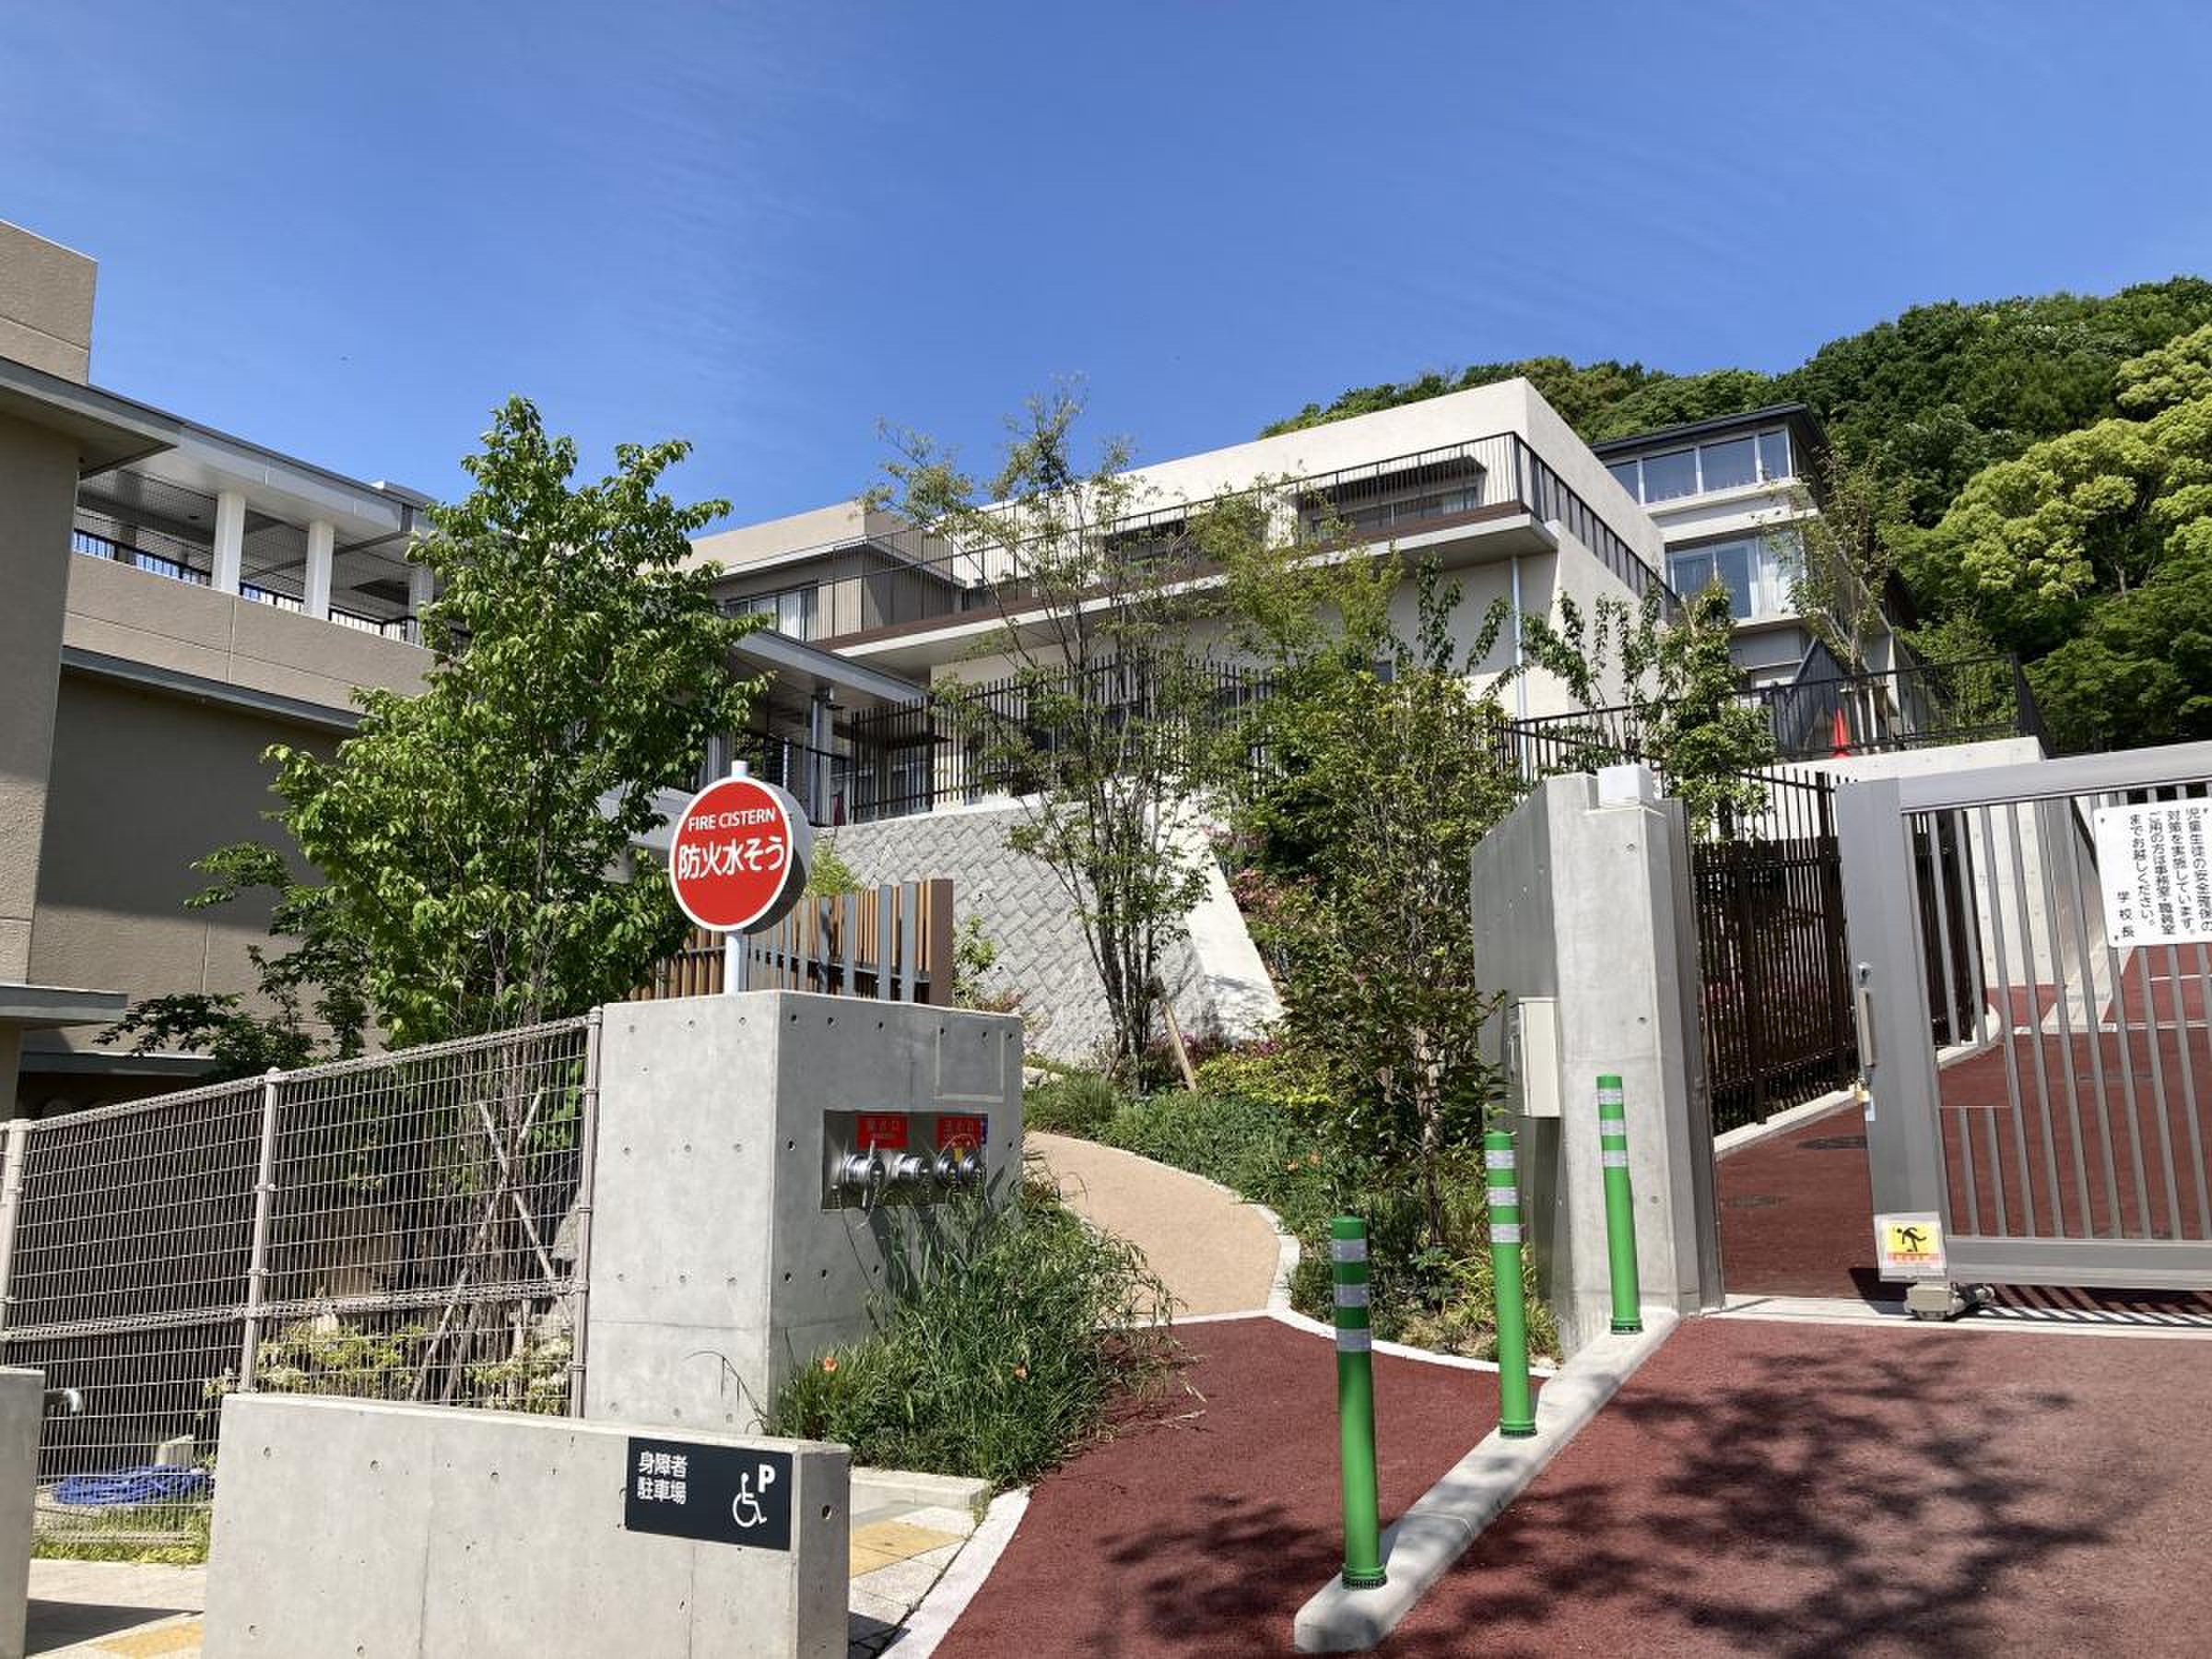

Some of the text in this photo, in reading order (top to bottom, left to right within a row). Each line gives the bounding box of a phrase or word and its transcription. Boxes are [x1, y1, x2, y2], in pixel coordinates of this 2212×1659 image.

[688, 807, 776, 832] FIRE CISTERN
[678, 836, 784, 880] 防火水そう
[2116, 890, 2136, 938] 学校長
[638, 1450, 688, 1478] 身障者
[758, 1464, 776, 1493] P
[637, 1476, 688, 1505] 駐車場
